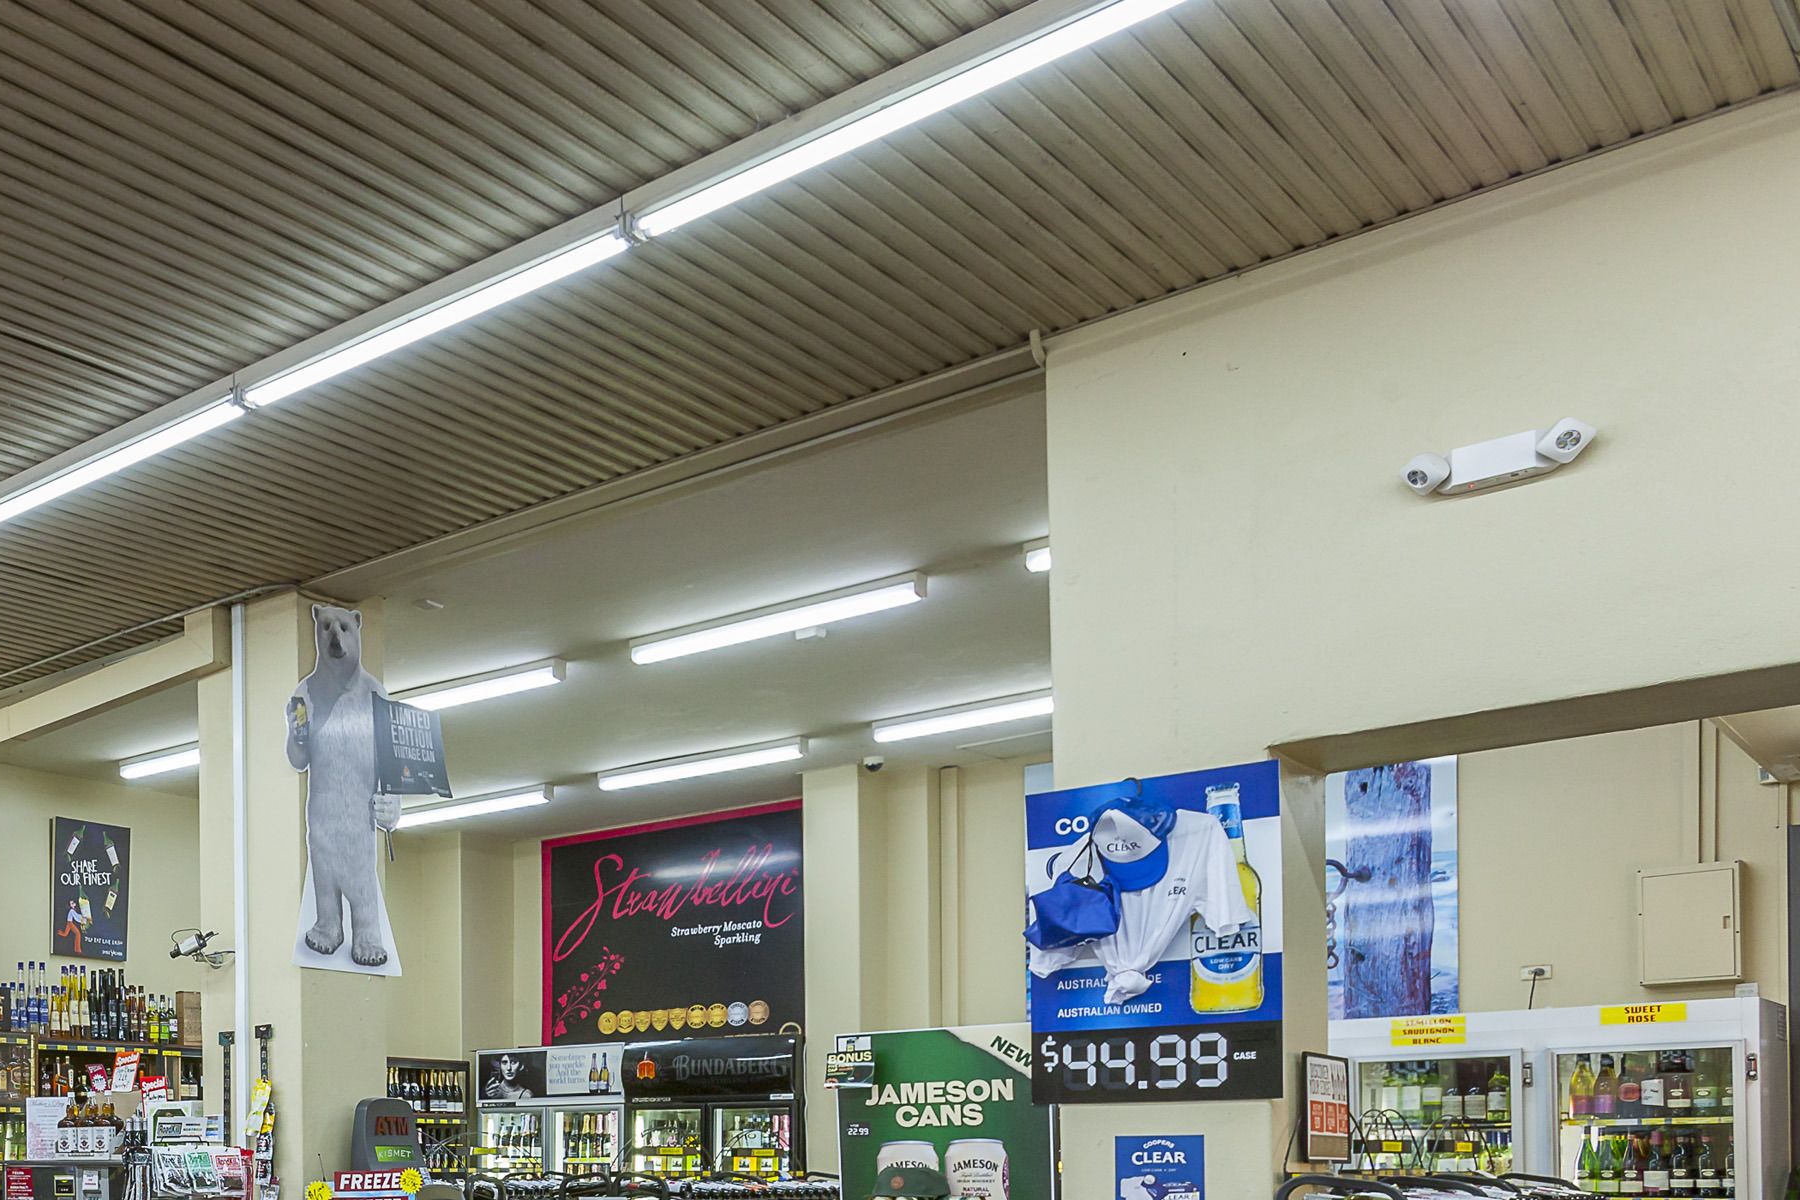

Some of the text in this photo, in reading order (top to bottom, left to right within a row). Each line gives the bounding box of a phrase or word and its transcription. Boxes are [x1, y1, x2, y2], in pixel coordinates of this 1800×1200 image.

[390, 704, 430, 729] LIMITED
[392, 725, 433, 749] EDITION
[393, 745, 435, 762] VINTAGE CAN
[71, 860, 98, 873] SHARE
[61, 872, 111, 885] OUR FINEST
[671, 920, 762, 937] Strawberry Moscato
[714, 933, 761, 948] Sparkling
[1195, 932, 1258, 953] CLEAR
[1057, 1003, 1161, 1018] AUSTRALIAN OWNED
[1624, 1005, 1662, 1014] SWEET
[1628, 1015, 1656, 1023] ROSE
[1402, 1027, 1455, 1035] SAUVIGNON
[828, 1051, 872, 1064] BONUS
[1233, 1051, 1256, 1060] CASE
[142, 1077, 165, 1092] Special
[866, 1078, 1014, 1106] JAMESON
[896, 1104, 983, 1127] CANS
[375, 1116, 408, 1136] ATM
[1143, 1139, 1175, 1149] COOPERS
[379, 1150, 411, 1158] KISMET
[1132, 1152, 1186, 1165] CLEAR
[952, 1159, 998, 1172] JAMESON
